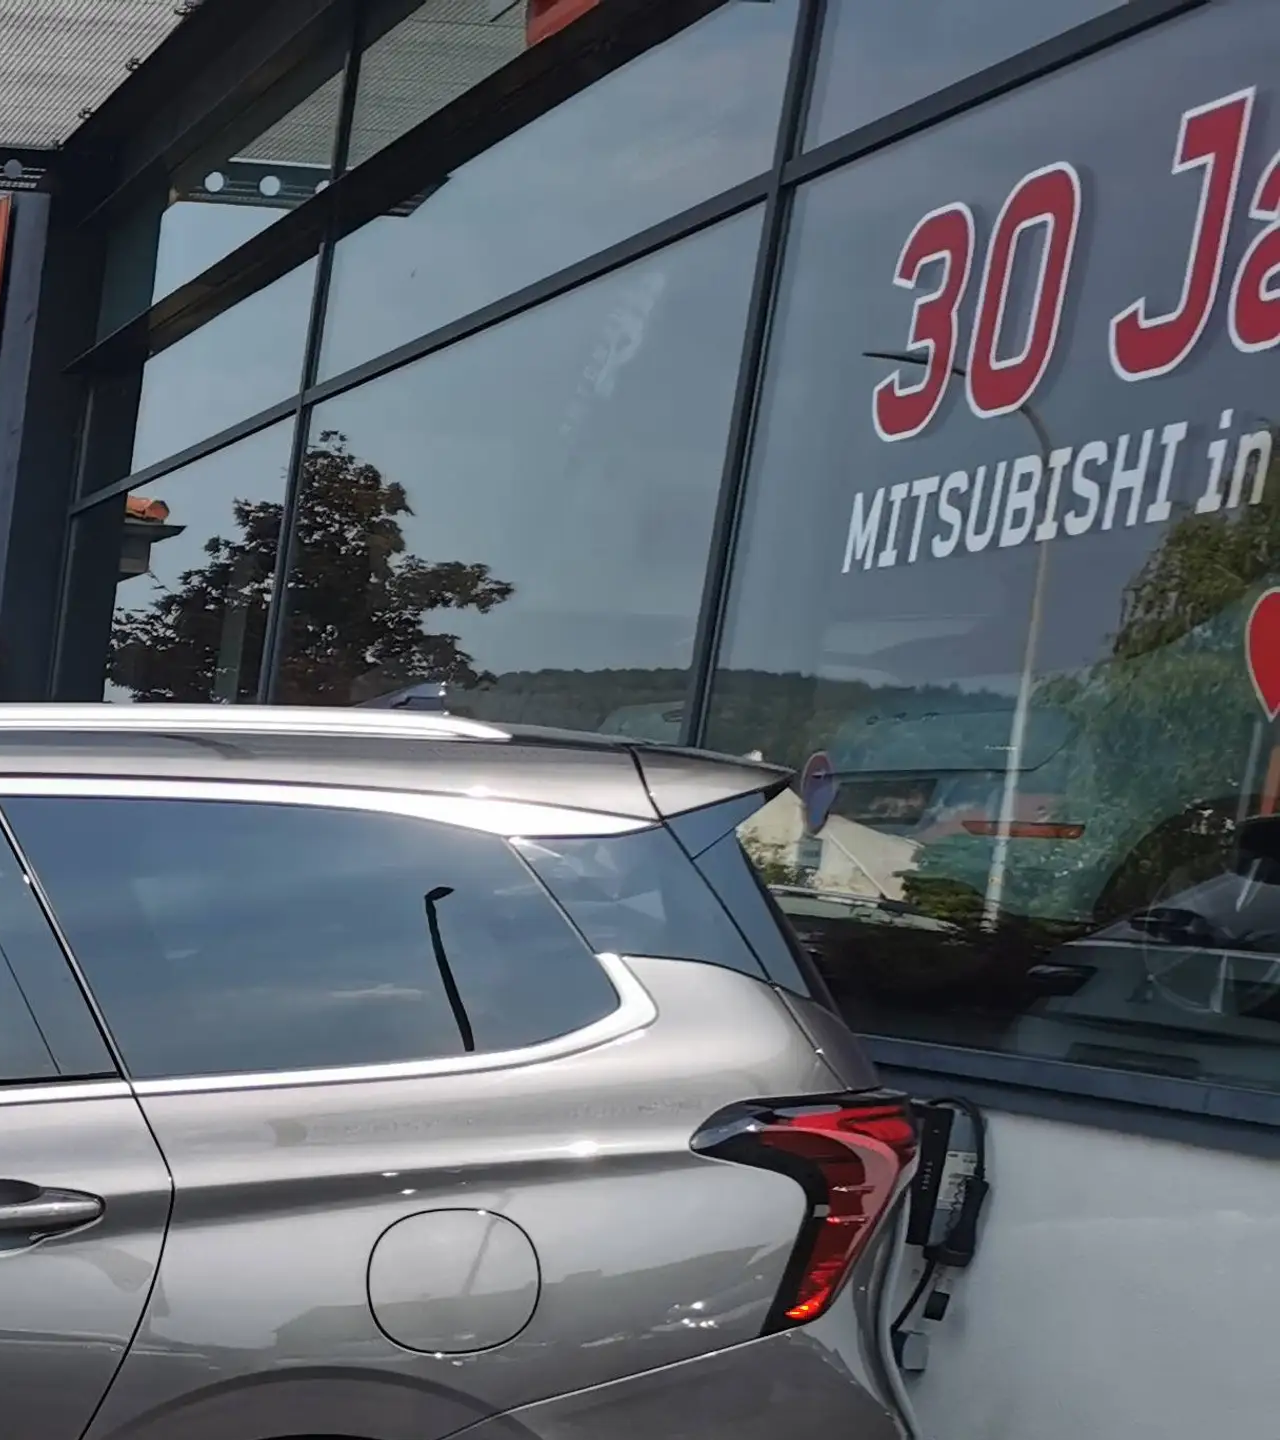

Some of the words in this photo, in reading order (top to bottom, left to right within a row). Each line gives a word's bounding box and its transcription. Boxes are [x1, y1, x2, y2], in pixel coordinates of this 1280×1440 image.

[872, 161, 1082, 443] 30
[841, 421, 1189, 575] MITSUBISHI
[1194, 408, 1273, 516] in
